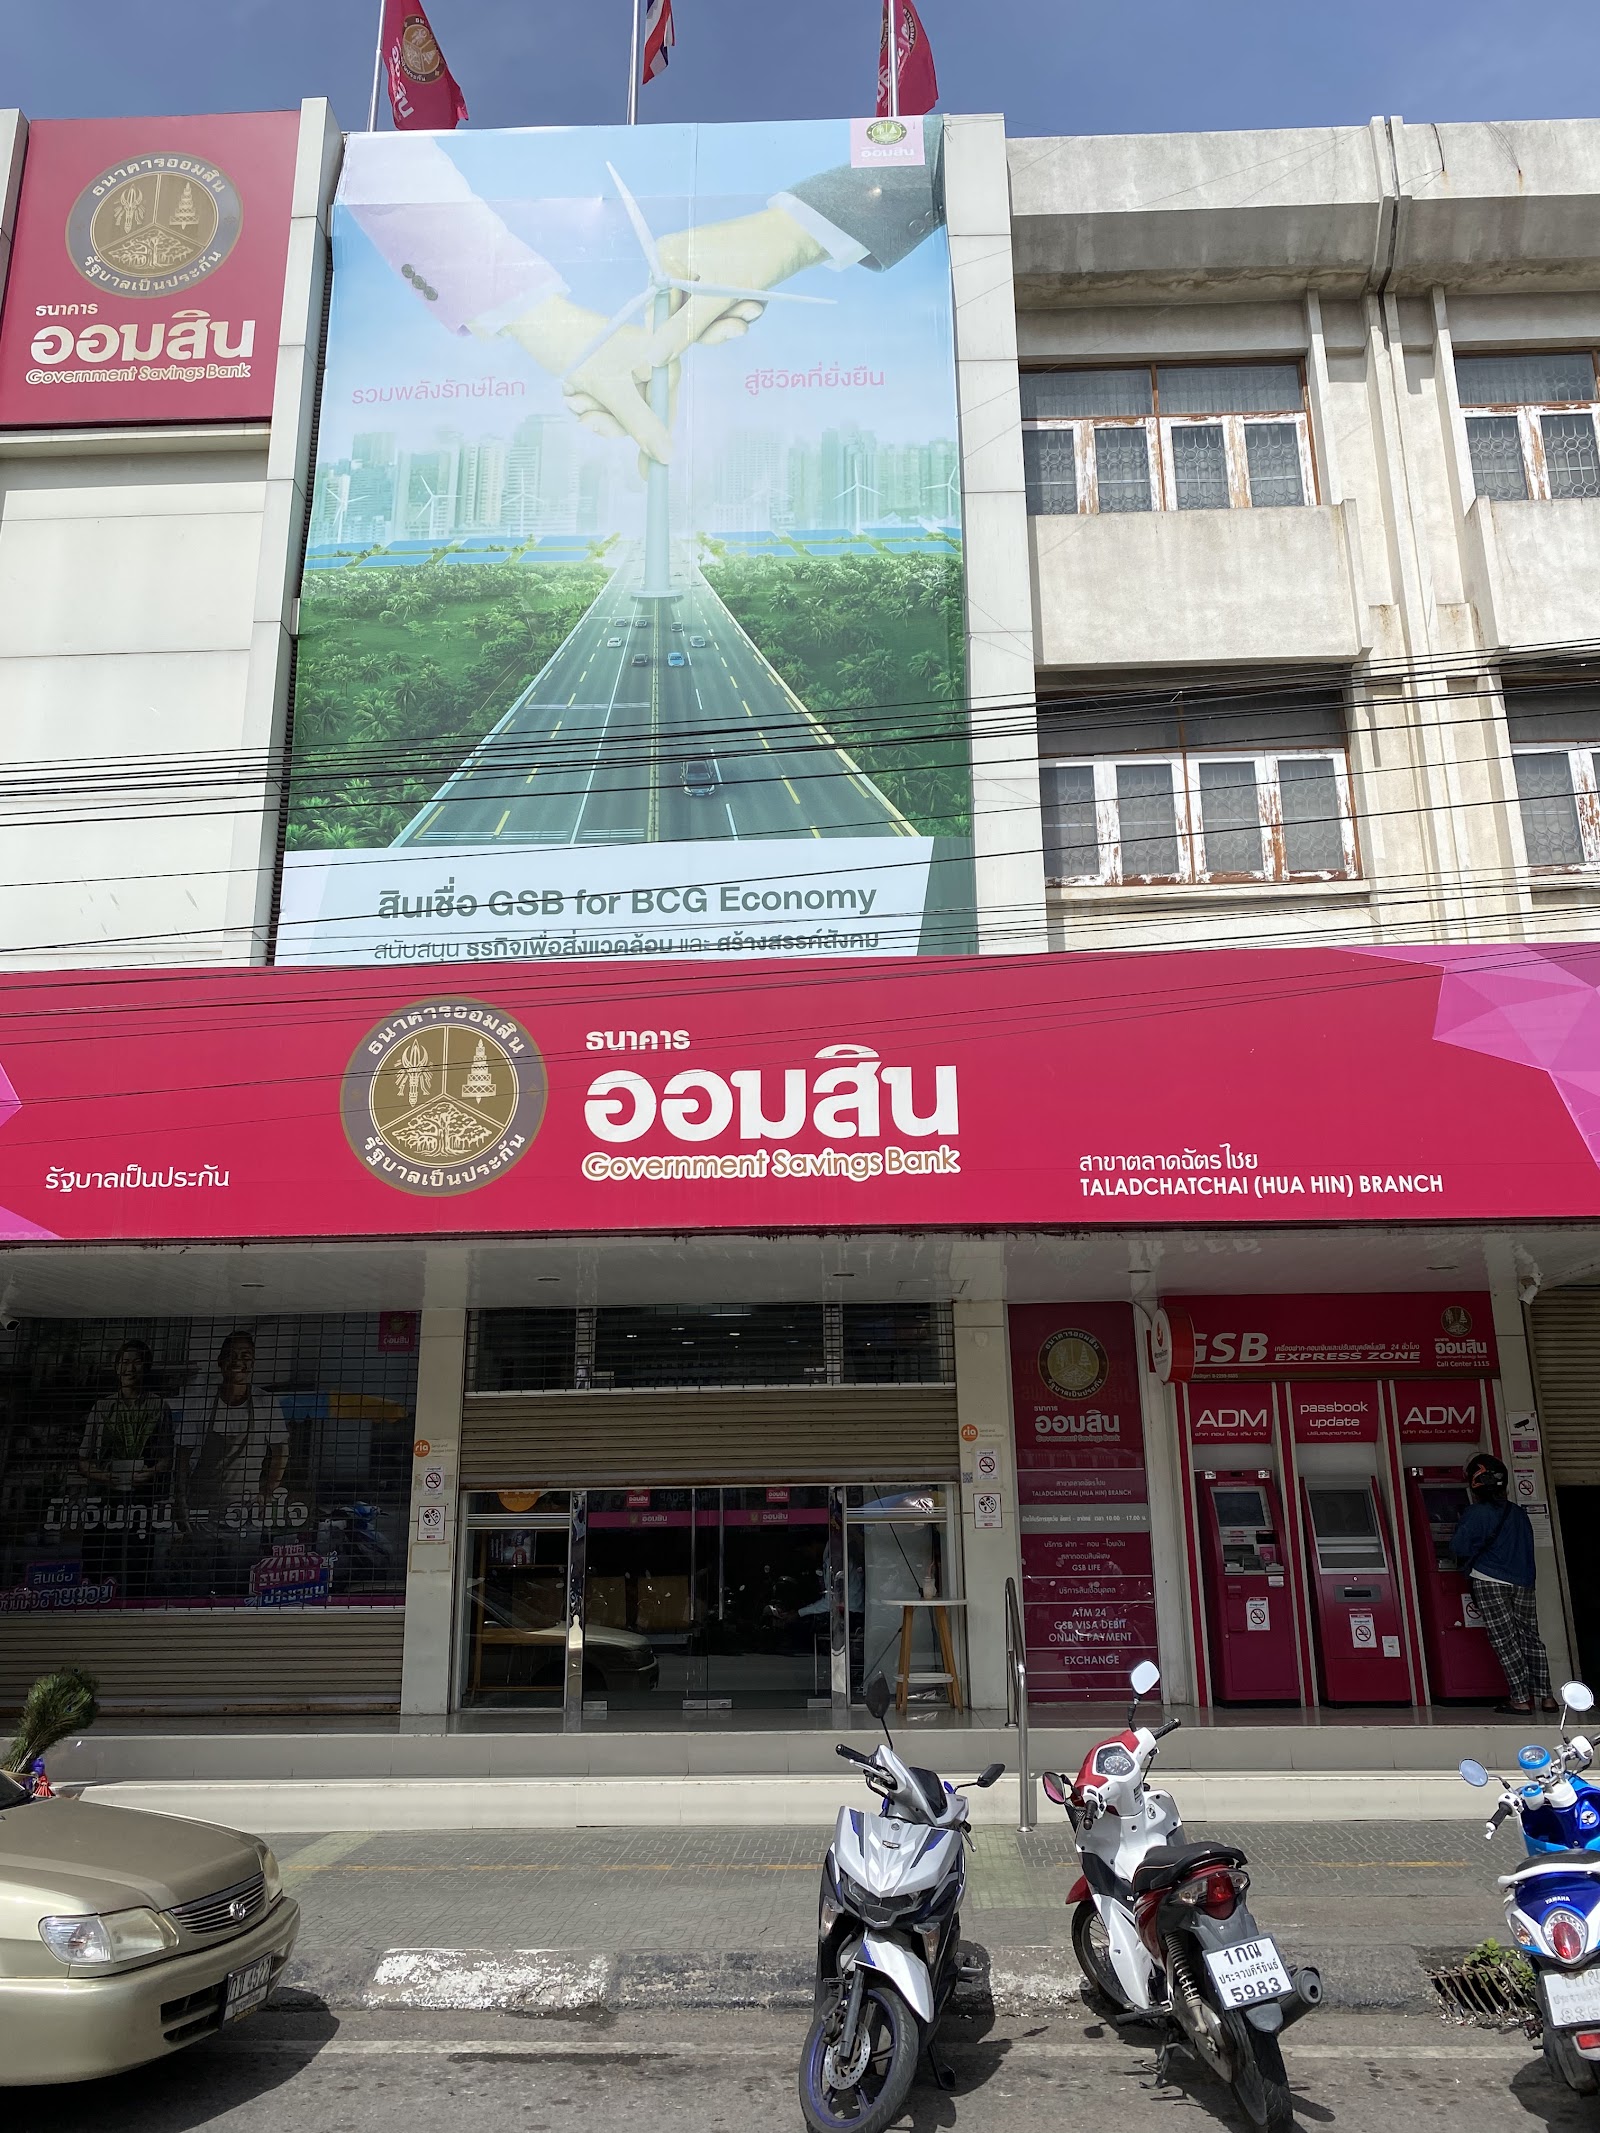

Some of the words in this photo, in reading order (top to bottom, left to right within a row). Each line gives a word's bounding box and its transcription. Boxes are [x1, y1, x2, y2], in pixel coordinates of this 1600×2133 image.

[92, 158, 226, 197] ธนาคารออมสิน
[84, 251, 222, 291] รัฐบาลเป็นประกัน
[36, 303, 98, 317] ธนาคาร
[31, 310, 256, 365] ออมสิน
[26, 366, 137, 384] Government
[138, 365, 205, 383] Savings
[206, 362, 252, 379] Bank
[744, 361, 885, 396] สู่ชีวิตที่ยั่งยืน
[351, 376, 526, 404] รวมพลังรักษ์โลก
[378, 876, 477, 919] สินเชื่อ
[488, 890, 564, 916] GSB
[576, 889, 621, 915] for
[631, 887, 708, 914] BCG
[720, 886, 877, 915] Economy
[374, 939, 460, 962] สนับสนุน
[466, 929, 673, 961] ธุรกิจเพื่อสิ่งแวดล้อม
[367, 1005, 526, 1055] ธนาคารออมสิน
[585, 1029, 691, 1051] ธนาคาร
[583, 1043, 960, 1143] ออมสิน
[364, 1133, 526, 1187] รัฐบาลเป็นประกัน
[581, 1148, 769, 1181] Government
[771, 1147, 882, 1182] Savings
[884, 1144, 962, 1175] Bank
[45, 1164, 230, 1192] รัฐบาลเป็นประกัน
[1080, 1177, 1249, 1197] TALADCHATCHAI
[1254, 1174, 1305, 1198] (HUA
[1310, 1174, 1354, 1198] HIN)
[1359, 1174, 1445, 1194] BRANCH
[1274, 1352, 1363, 1361] EXPRESS
[1367, 1351, 1421, 1360] ZONE
[1391, 1343, 1399, 1351] 24
[1434, 1338, 1488, 1355] ออมสิน
[1195, 1409, 1268, 1428] ADM
[1300, 1401, 1369, 1415] passbook
[1403, 1406, 1476, 1425] ADM
[963, 1426, 977, 1436] ria
[1034, 1409, 1120, 1434] ออมสิน
[1309, 1416, 1360, 1428] update
[415, 1443, 429, 1452] ria
[1032, 1489, 1079, 1497] TALADCHATCHAI
[1072, 1608, 1093, 1617] ATM
[1095, 1608, 1107, 1617] 24
[1054, 1620, 1074, 1630] GSB
[1075, 1620, 1099, 1630] VISA
[1101, 1620, 1127, 1630] DEBIT
[1048, 1632, 1086, 1643] ONLINE
[1088, 1632, 1133, 1642] PAYMENT
[1064, 1655, 1120, 1665] EXCHANGE
[1545, 1896, 1571, 1905] YAMAHA
[1230, 1977, 1282, 2003] 5983
